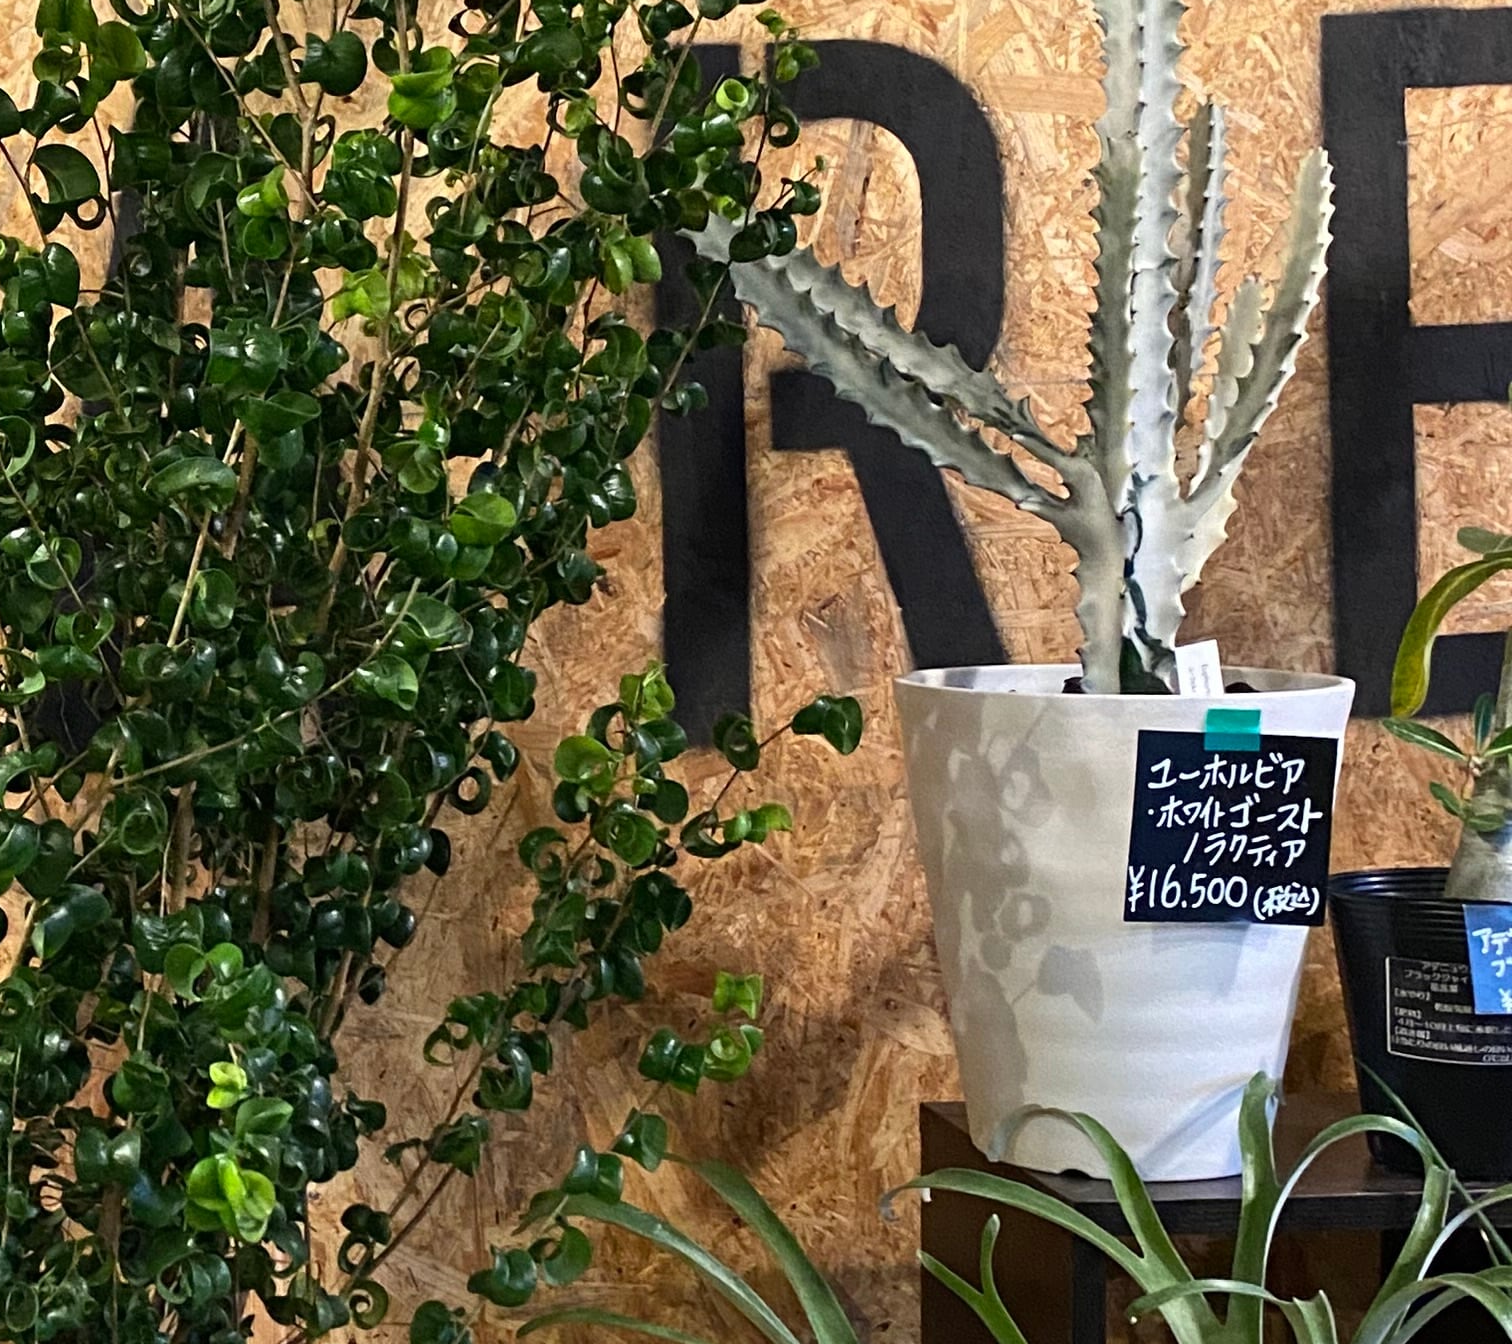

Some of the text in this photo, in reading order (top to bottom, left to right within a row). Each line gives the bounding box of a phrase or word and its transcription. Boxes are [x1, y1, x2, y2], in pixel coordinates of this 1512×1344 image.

[1147, 752, 1306, 795] ユーホルビア
